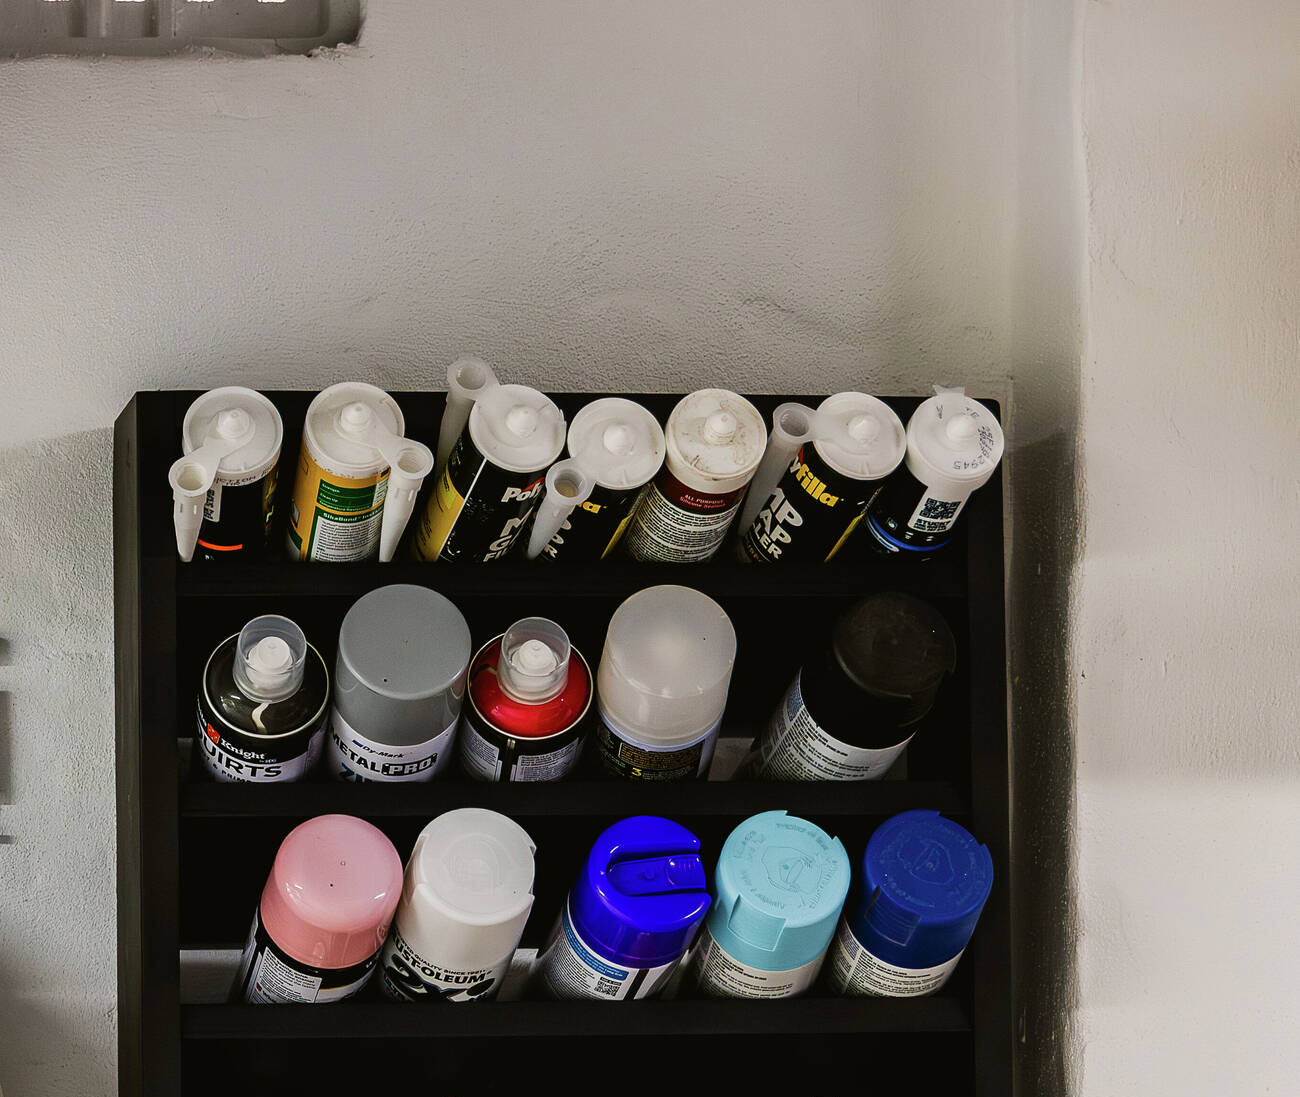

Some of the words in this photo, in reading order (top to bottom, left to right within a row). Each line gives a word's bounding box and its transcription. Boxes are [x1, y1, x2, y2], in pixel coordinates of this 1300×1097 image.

[220, 738, 265, 760] Knight
[362, 745, 405, 759] Dy-Mark
[631, 767, 642, 777] 3
